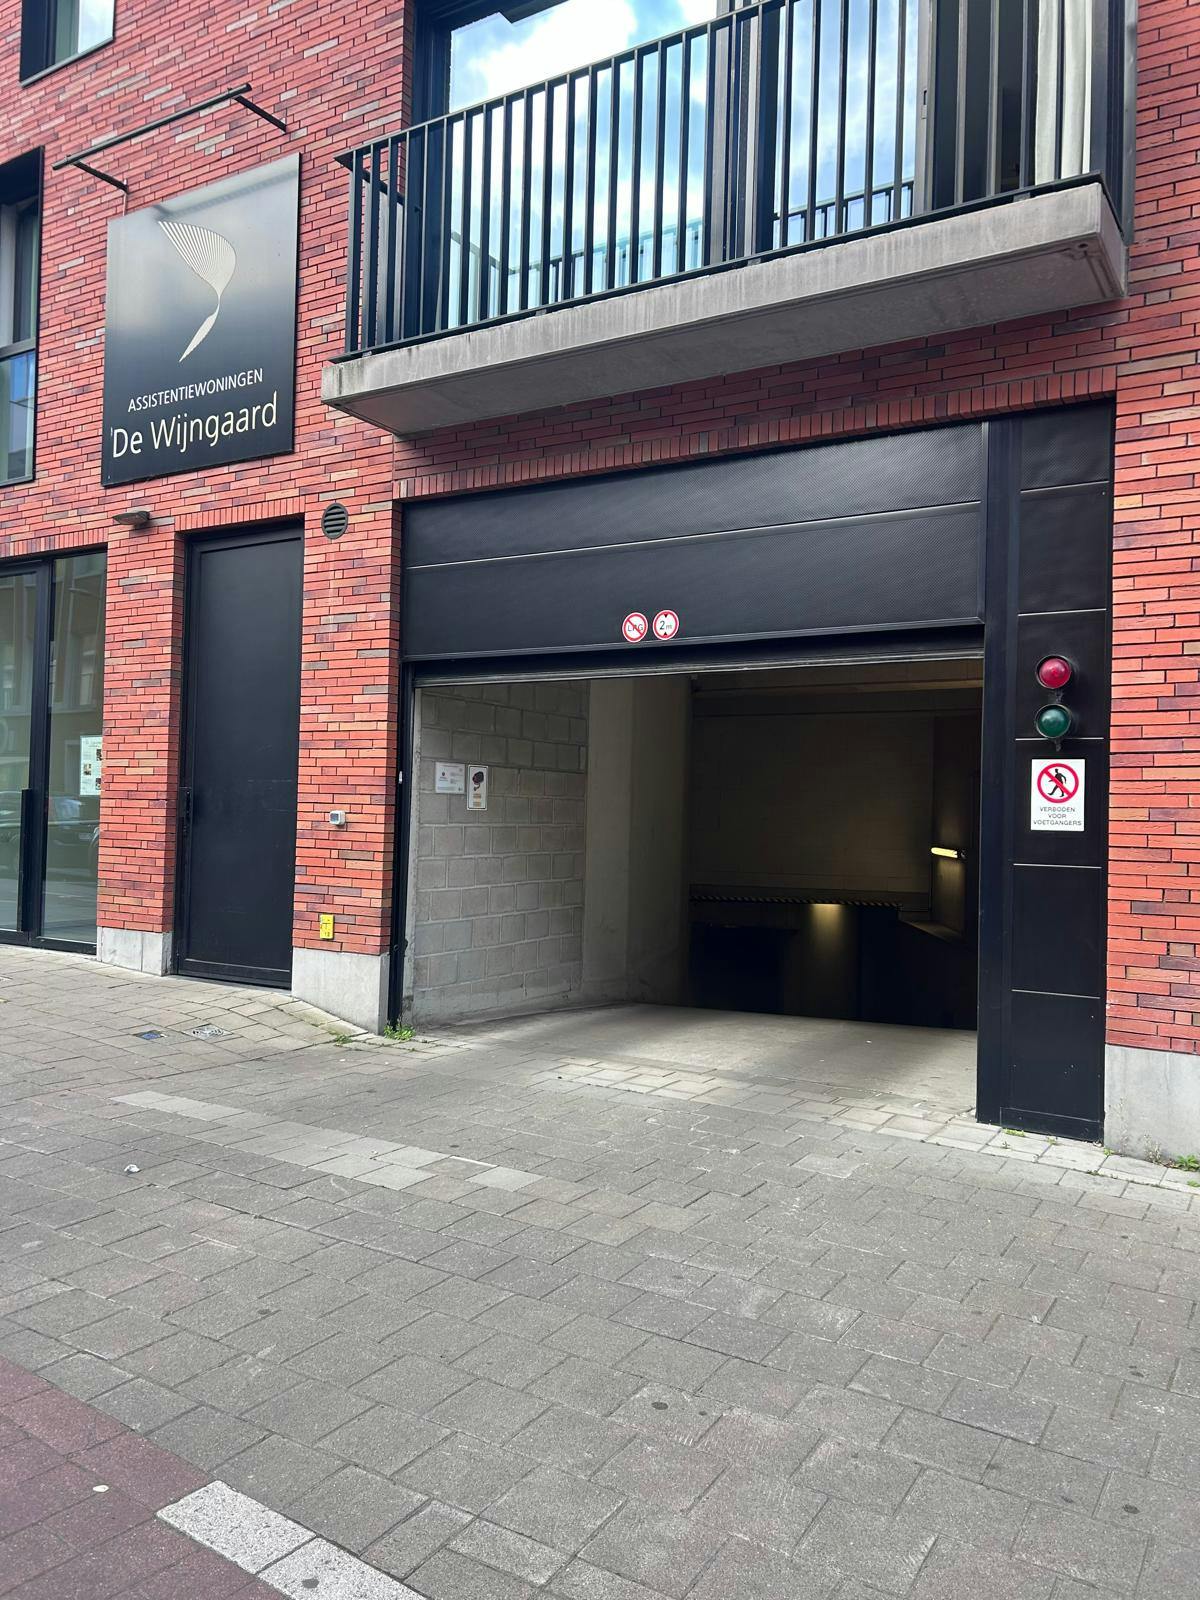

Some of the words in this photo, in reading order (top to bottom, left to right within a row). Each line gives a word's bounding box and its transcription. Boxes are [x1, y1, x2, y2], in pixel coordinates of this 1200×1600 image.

[128, 368, 263, 412] ASSISTENTIEWONINGEN
[112, 428, 143, 458] De
[151, 391, 277, 453] Wijngaard
